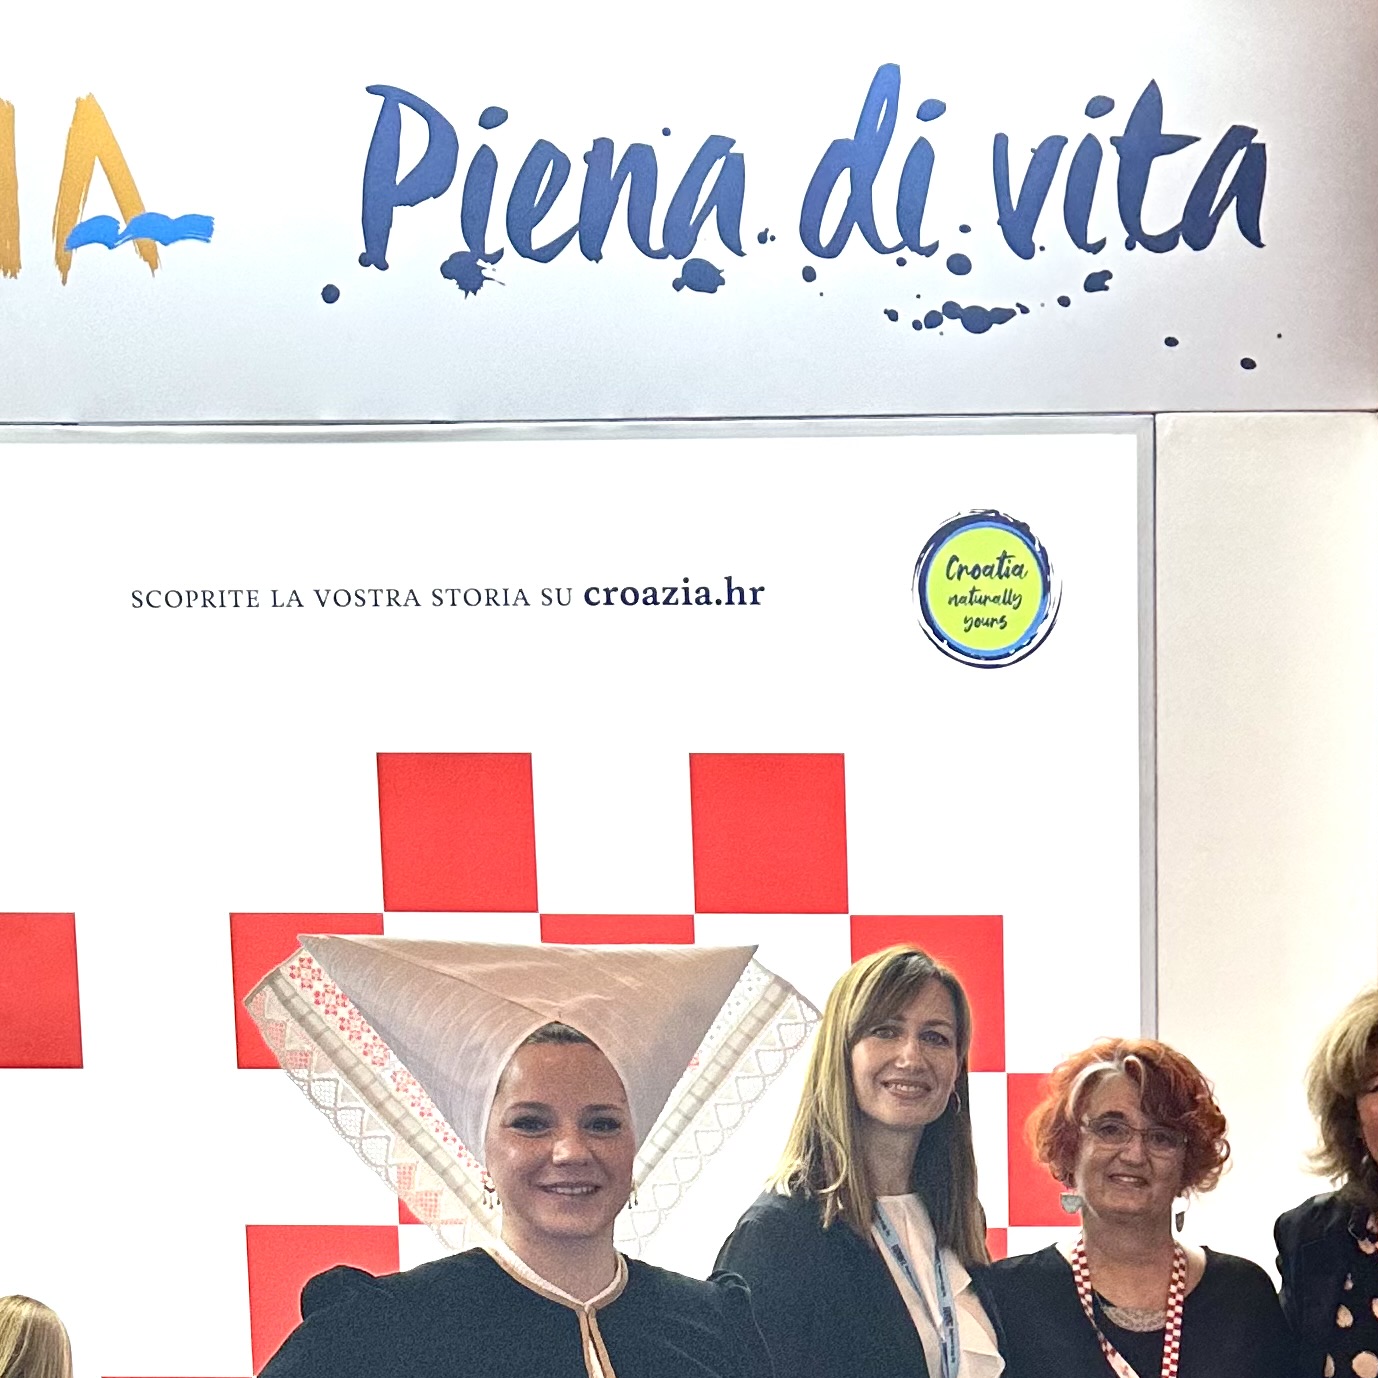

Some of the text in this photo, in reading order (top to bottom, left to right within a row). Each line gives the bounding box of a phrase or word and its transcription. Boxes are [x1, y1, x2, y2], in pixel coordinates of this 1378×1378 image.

[359, 62, 1267, 272] Piena di vita
[945, 549, 1029, 581] Croatia
[131, 575, 766, 609] SCOPRITE LA VOSTRA STORIA SU croazia.hr
[947, 585, 1023, 610] naturally
[963, 614, 1008, 633] yours
